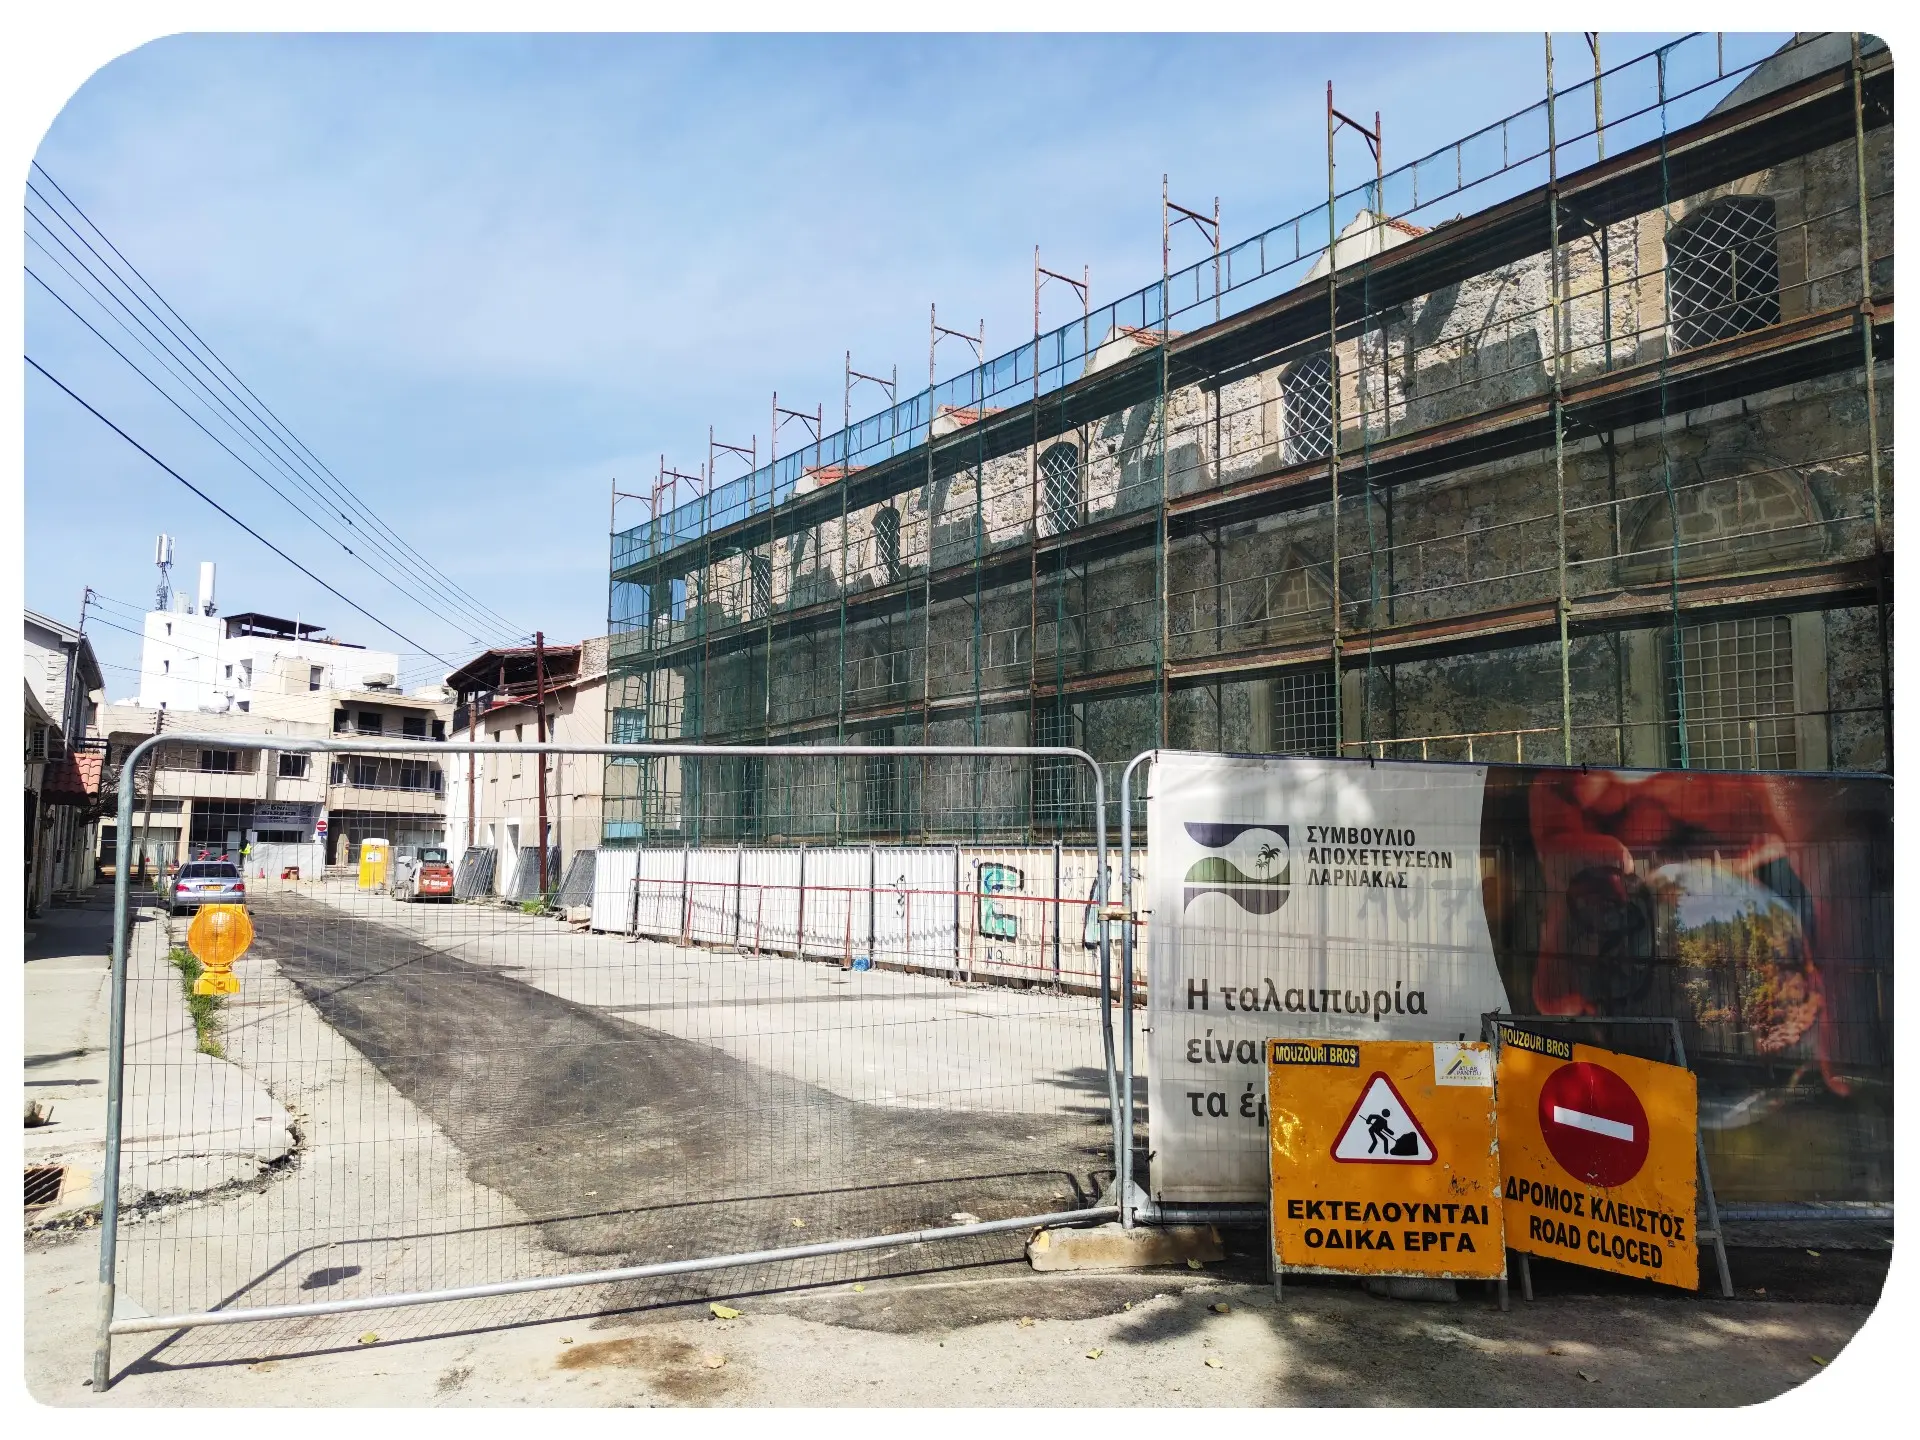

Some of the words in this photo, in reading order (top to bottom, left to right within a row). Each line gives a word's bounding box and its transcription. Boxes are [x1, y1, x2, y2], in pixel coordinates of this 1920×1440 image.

[1306, 825, 1416, 847] ΣΥΜΒΟΥΛΙΟ
[1307, 846, 1453, 869] ΑΠΟΧΕΤΕΥΣΕΩΝ
[1307, 868, 1408, 889] ΛΑΡΝΑΚΑΣ
[1187, 978, 1209, 1011] Η
[1219, 978, 1428, 1022] ταλαιπωρία
[1275, 1045, 1328, 1063] MOUZOURI
[1329, 1049, 1356, 1065] BROS
[1546, 1038, 1570, 1058] BROS
[1187, 1090, 1229, 1117] τα
[1287, 1199, 1489, 1225] ΕΚΤΕΛΟΥΝΤΑΙ
[1505, 1175, 1585, 1217] ΔΡΟΜΟΣ
[1590, 1196, 1686, 1241] ΚΛΕΙΣΤΟΣ
[1304, 1227, 1395, 1251] ΟΔΙΚΑ
[1403, 1230, 1477, 1253] ΕΡΓΑ
[1529, 1214, 1581, 1249] ROAD
[1587, 1229, 1663, 1269] CLOCED
